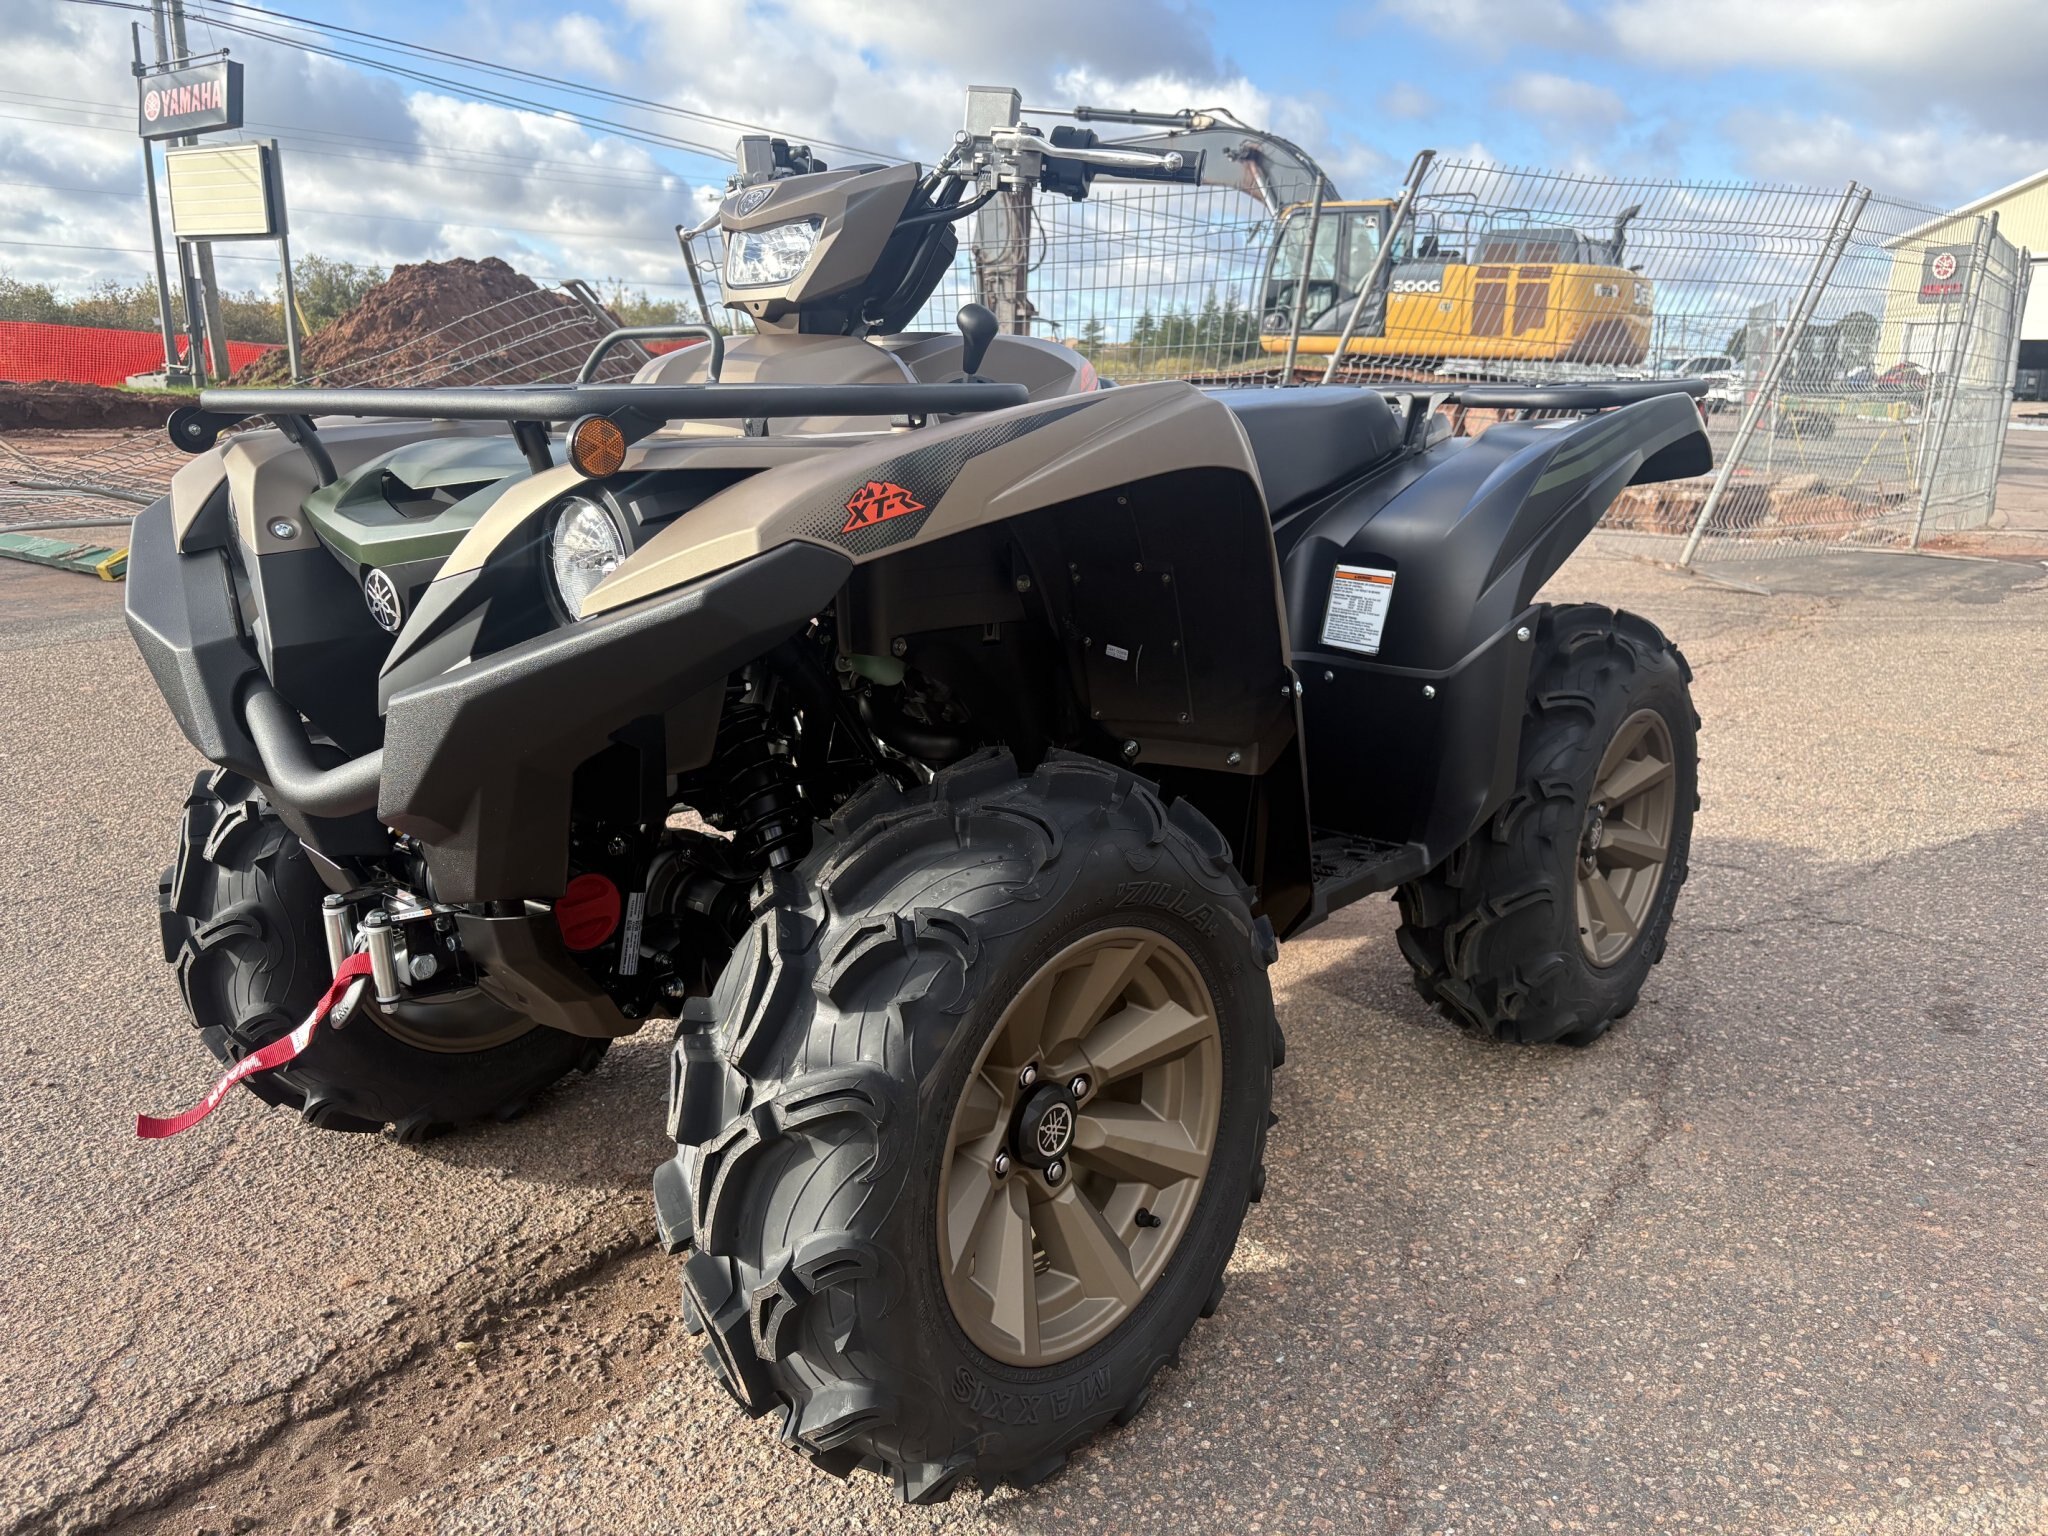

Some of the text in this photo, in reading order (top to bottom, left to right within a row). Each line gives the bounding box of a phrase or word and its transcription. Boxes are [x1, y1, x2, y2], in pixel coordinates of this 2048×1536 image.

[161, 80, 222, 117] YAMAHA
[1392, 280, 1440, 293] 300G
[951, 1364, 1112, 1425] MAXXIS
